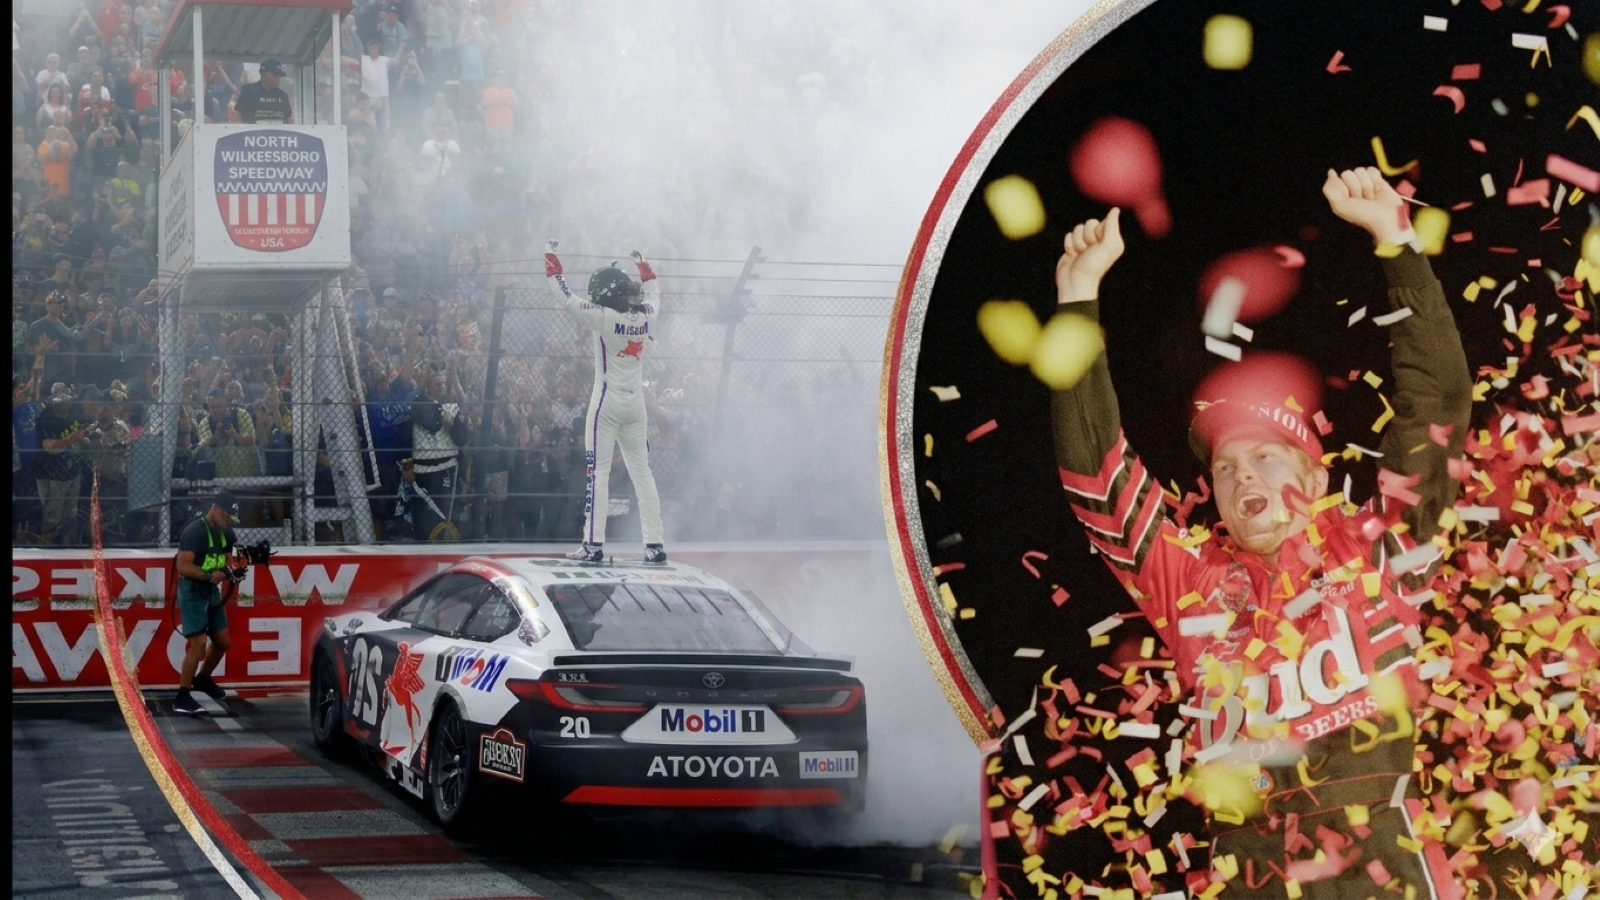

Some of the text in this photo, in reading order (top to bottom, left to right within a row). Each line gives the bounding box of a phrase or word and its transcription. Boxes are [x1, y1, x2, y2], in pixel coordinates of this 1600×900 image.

[244, 136, 298, 148] NORTH
[228, 168, 314, 179] SPEEDWAY
[558, 716, 591, 739] 20
[660, 708, 737, 733] Mobil
[646, 756, 780, 778] ATOYOTA
[804, 757, 843, 773] Mobil
